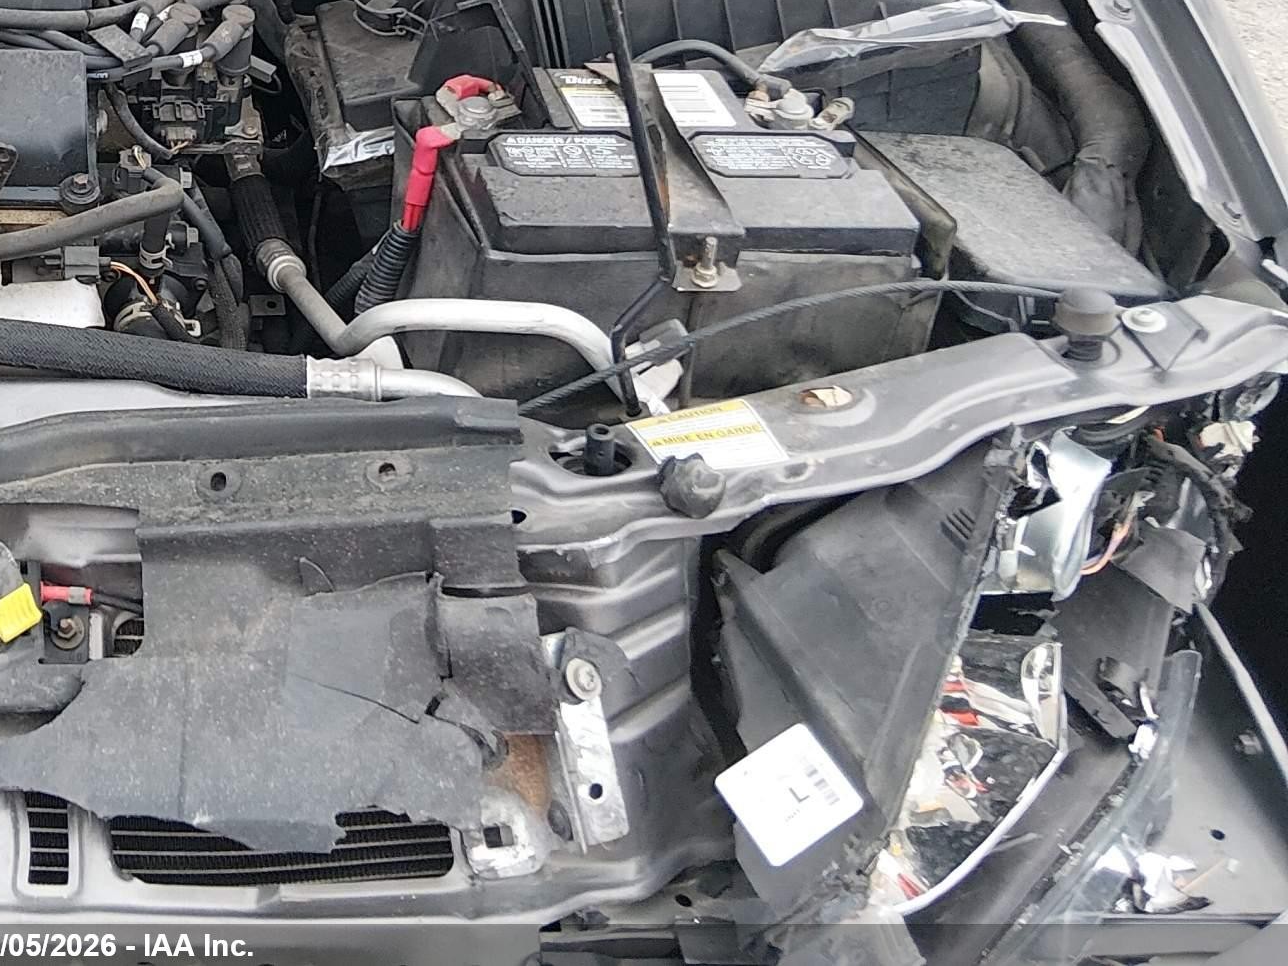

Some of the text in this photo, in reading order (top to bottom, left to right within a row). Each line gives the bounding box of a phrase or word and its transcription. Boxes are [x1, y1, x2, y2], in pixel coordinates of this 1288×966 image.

[559, 75, 603, 85] Dura
[667, 406, 723, 421] CAUTION
[662, 434, 691, 446] MISE
[696, 432, 713, 441] EN
